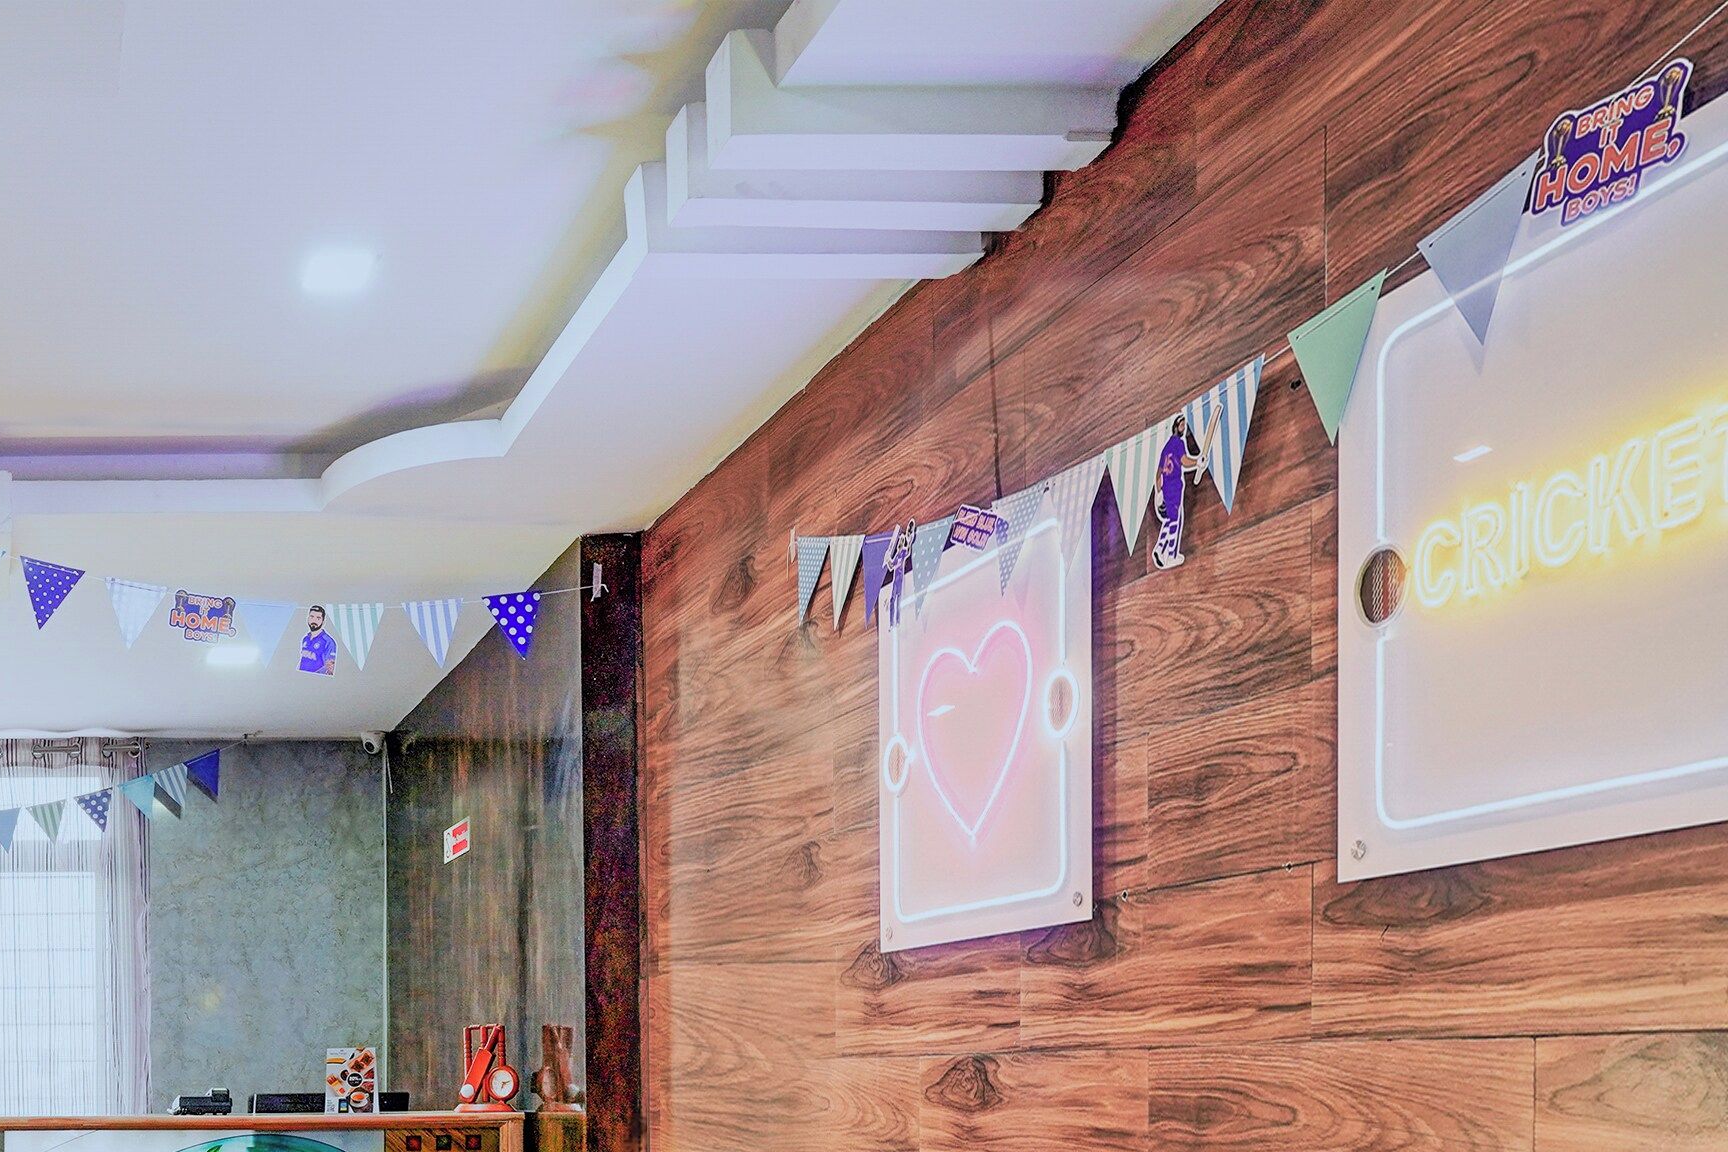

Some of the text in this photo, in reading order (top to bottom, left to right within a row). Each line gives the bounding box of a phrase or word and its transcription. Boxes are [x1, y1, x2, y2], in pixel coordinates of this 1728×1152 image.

[1576, 85, 1654, 139] BRING
[1599, 118, 1624, 148] IT
[1536, 119, 1680, 211] HOME,
[1565, 173, 1638, 222] BOYS!
[188, 596, 223, 609] BRING
